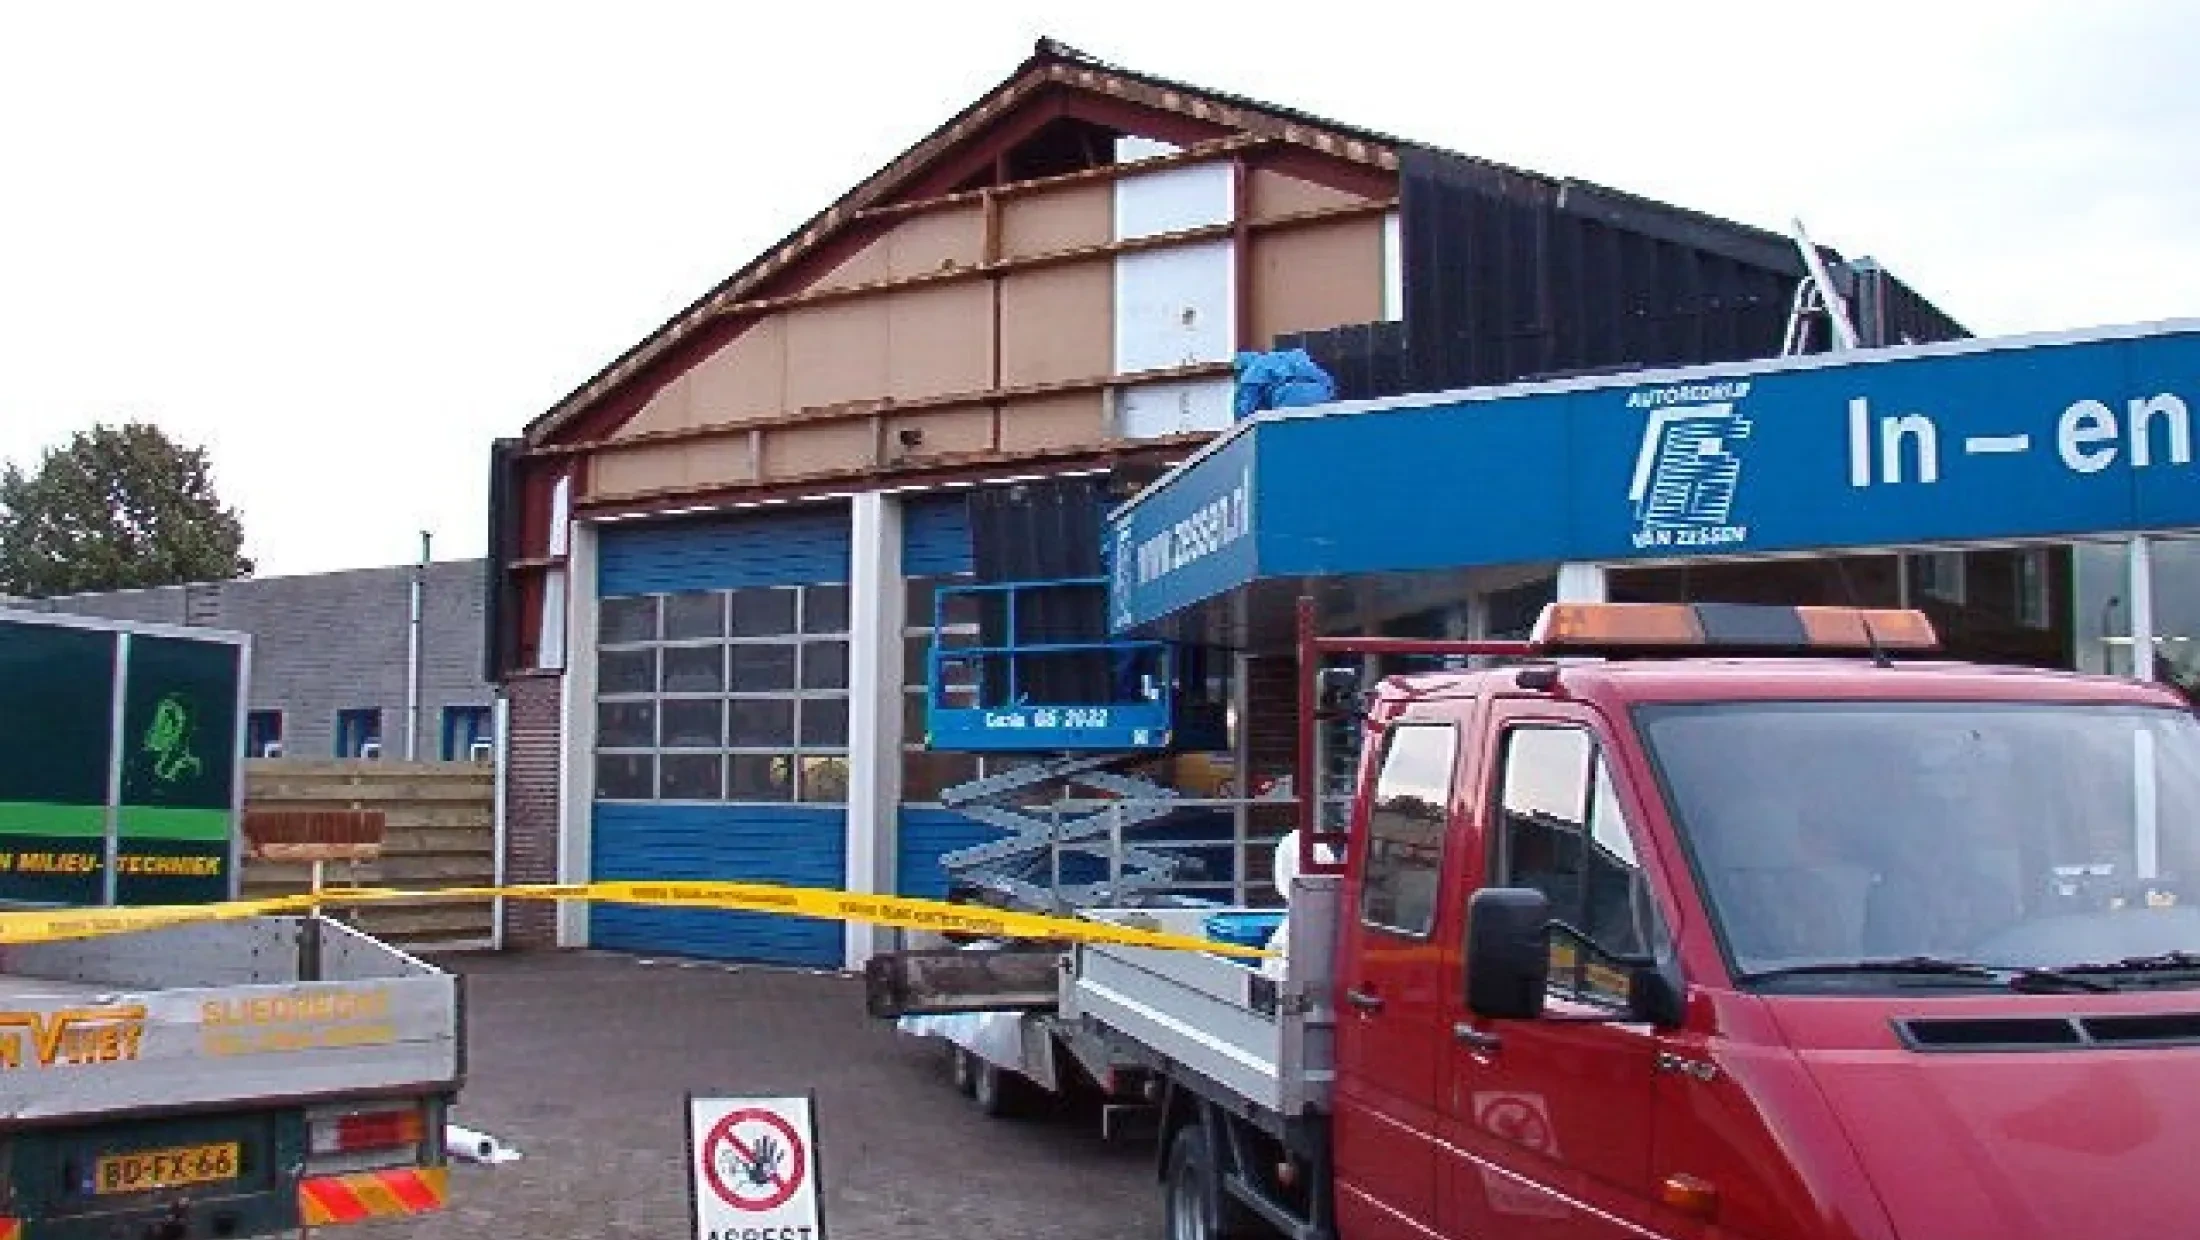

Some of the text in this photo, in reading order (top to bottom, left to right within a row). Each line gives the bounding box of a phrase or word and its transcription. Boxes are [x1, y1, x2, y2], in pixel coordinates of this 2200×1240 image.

[1849, 396, 1938, 487] In
[2057, 392, 2191, 473] en
[1632, 526, 1747, 548] VAN ZESSEN
